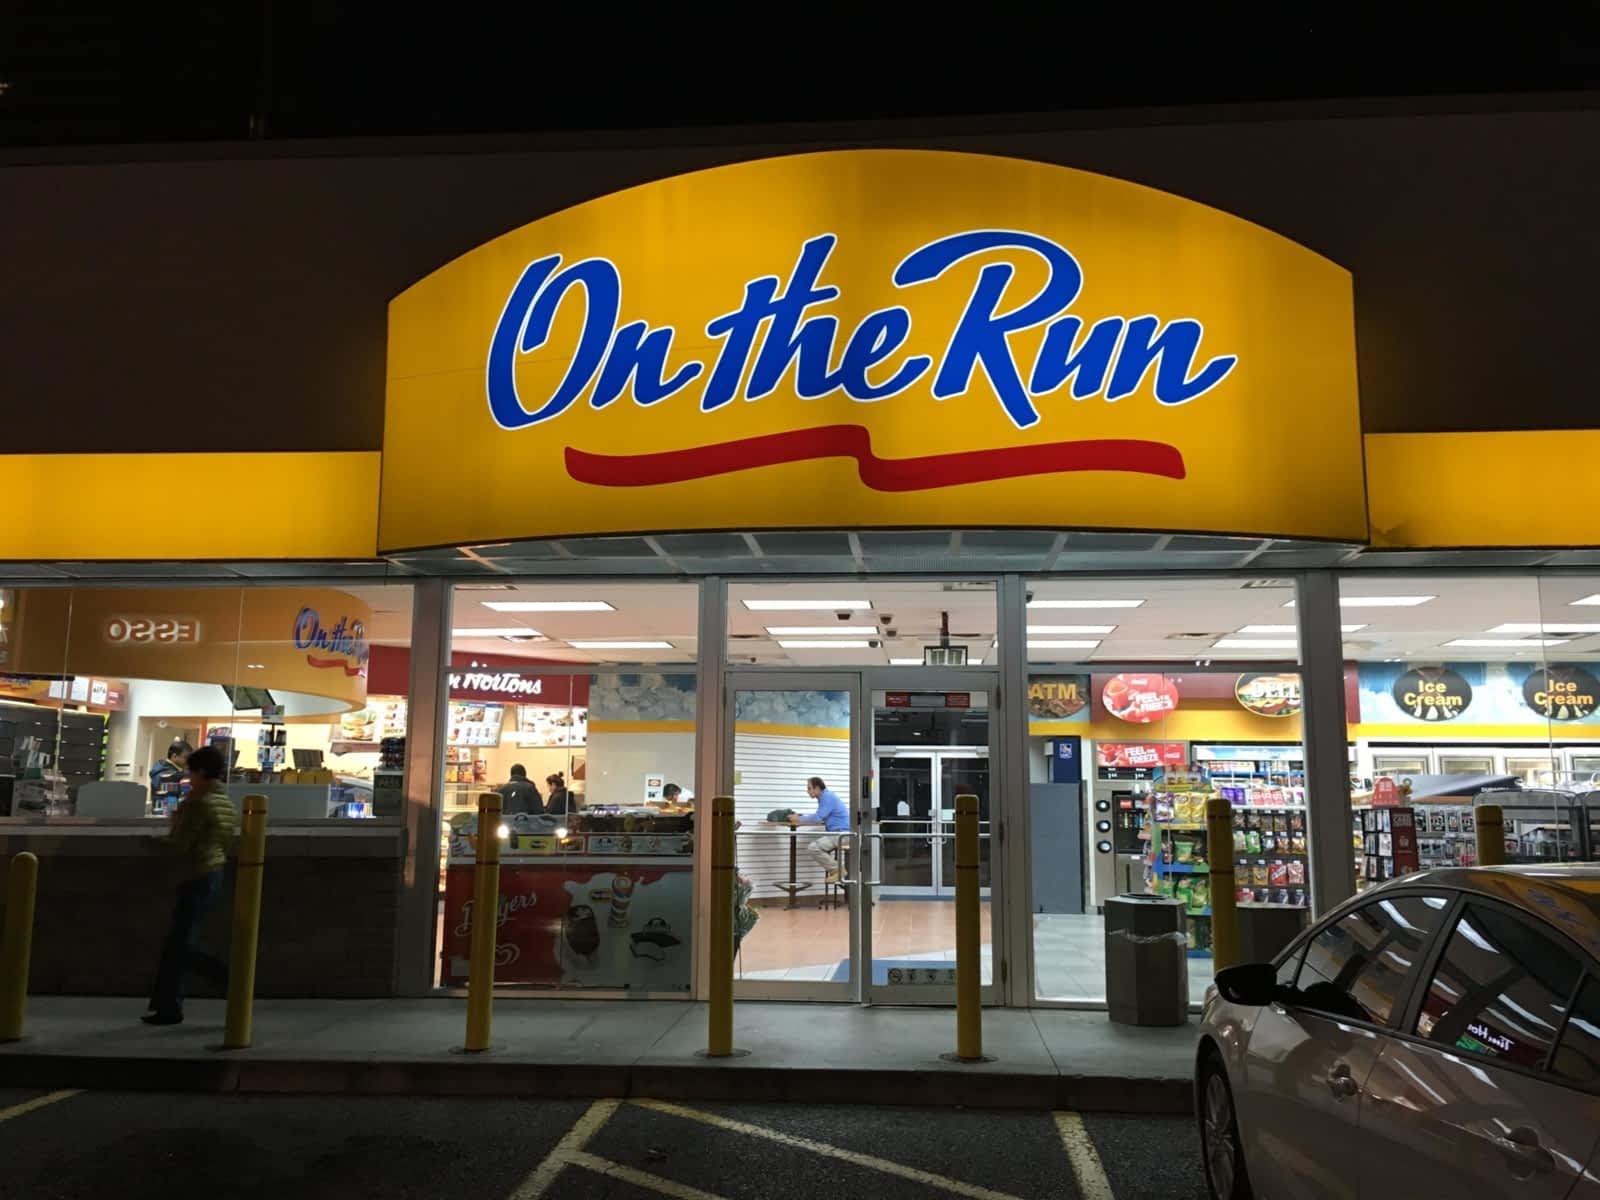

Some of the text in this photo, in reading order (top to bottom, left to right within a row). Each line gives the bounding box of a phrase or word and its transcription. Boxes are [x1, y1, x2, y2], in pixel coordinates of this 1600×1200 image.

[487, 229, 1239, 430] On the Run
[293, 607, 328, 649] On
[1029, 684, 1076, 700] ATM
[1418, 680, 1447, 693] Ice
[1549, 680, 1577, 693] Ice
[1404, 692, 1463, 706] Cream
[1534, 692, 1593, 706] Cream
[455, 891, 537, 937] yers
